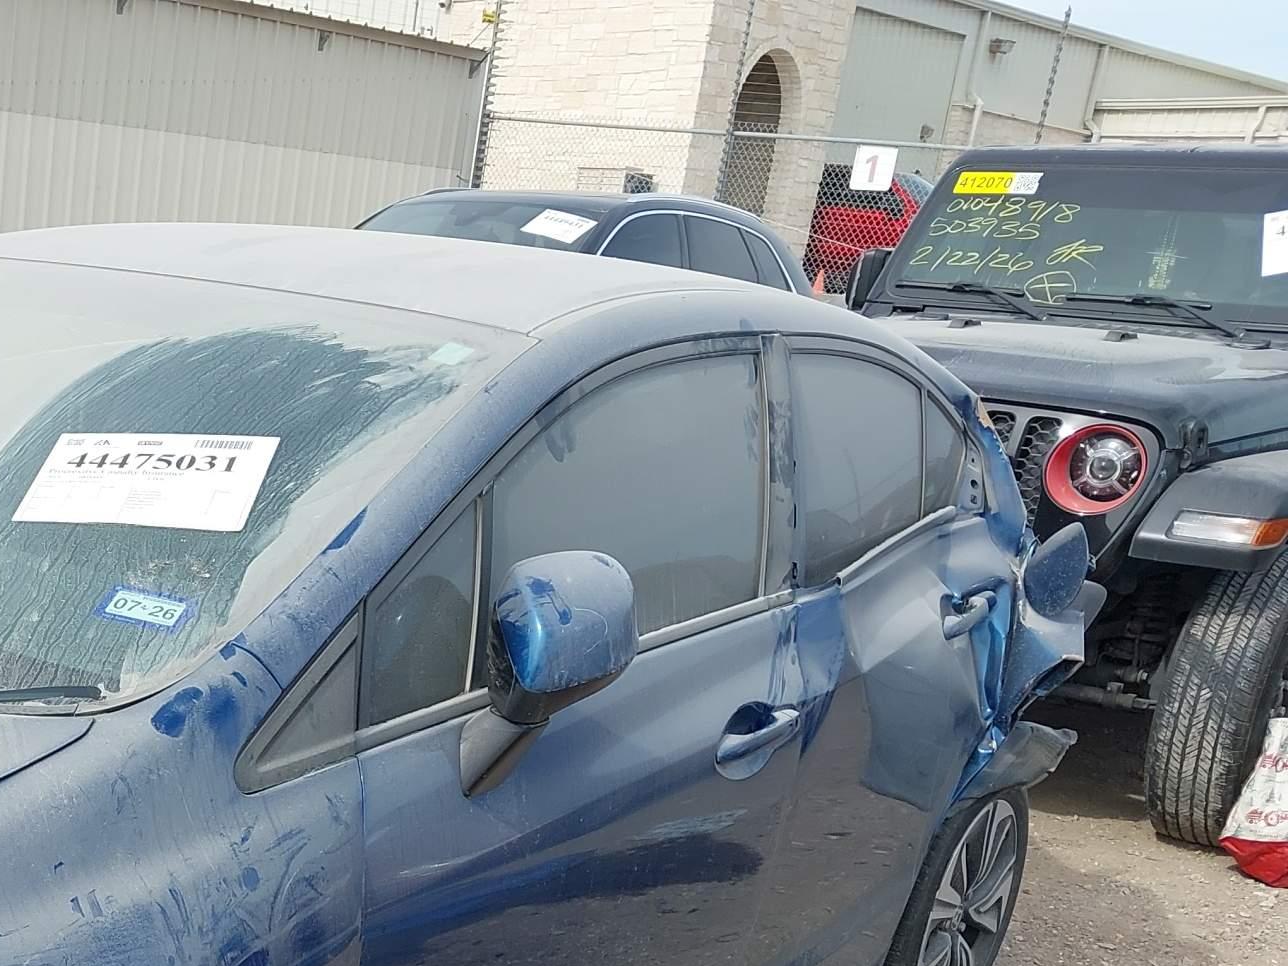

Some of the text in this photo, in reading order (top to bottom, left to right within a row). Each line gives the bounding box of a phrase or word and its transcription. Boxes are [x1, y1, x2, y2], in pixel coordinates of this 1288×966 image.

[865, 155, 879, 183] 1
[958, 176, 1014, 189] 412070
[929, 217, 1041, 240] 503935
[909, 246, 1035, 276] 2/22/26
[66, 452, 238, 473] 44475031
[113, 598, 142, 612] 07
[148, 606, 177, 621] 26
